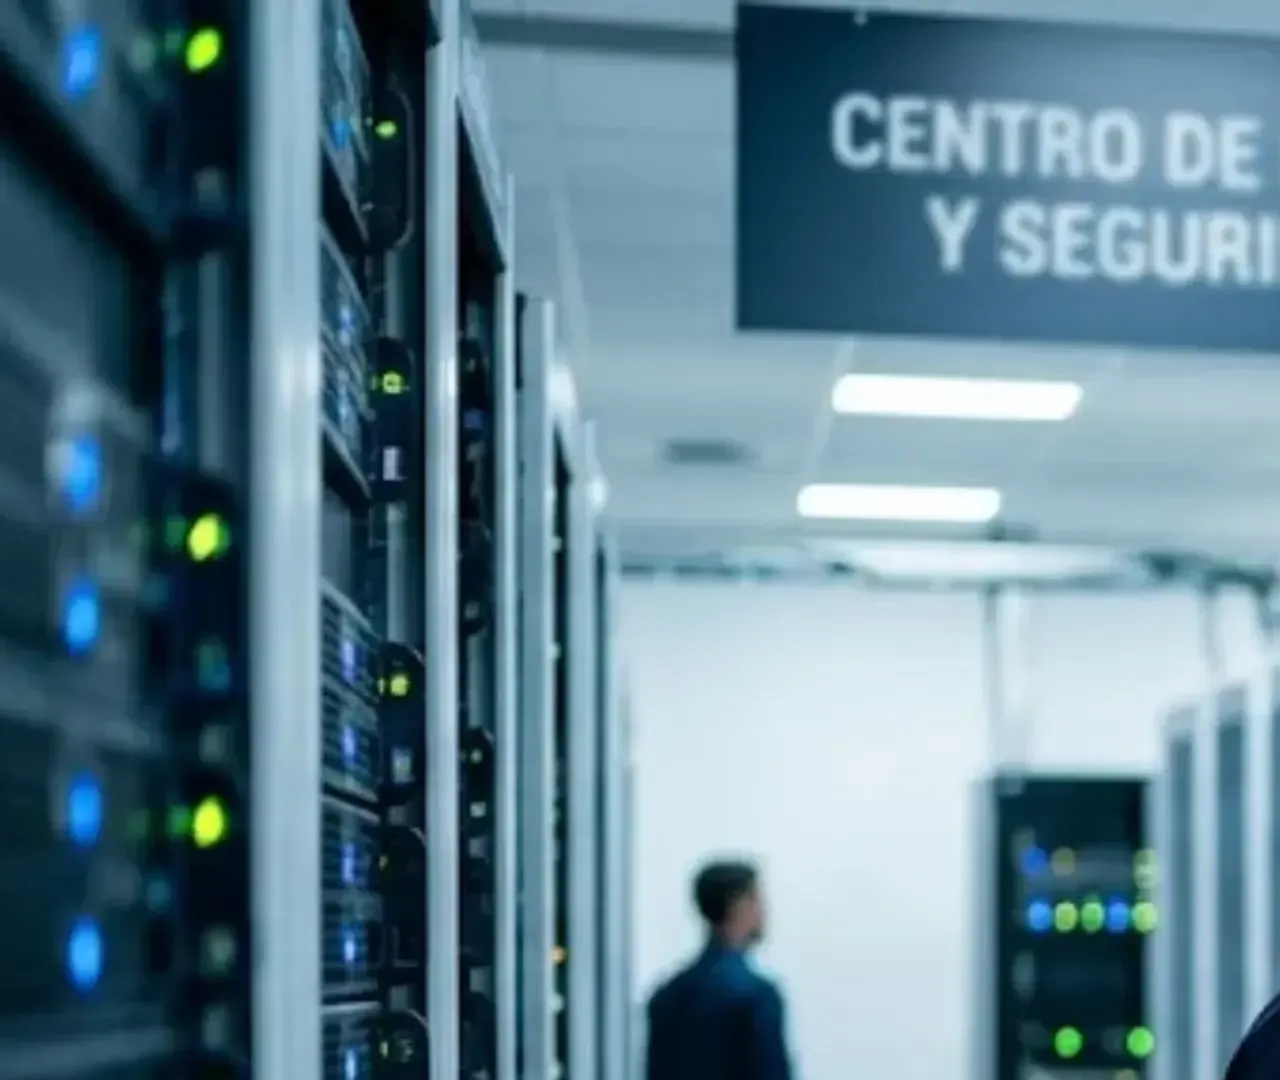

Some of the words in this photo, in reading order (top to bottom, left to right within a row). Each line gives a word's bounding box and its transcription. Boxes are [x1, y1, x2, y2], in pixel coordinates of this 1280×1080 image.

[831, 92, 1141, 184] CENTRO
[1165, 113, 1261, 188] DE
[925, 196, 980, 272] Y
